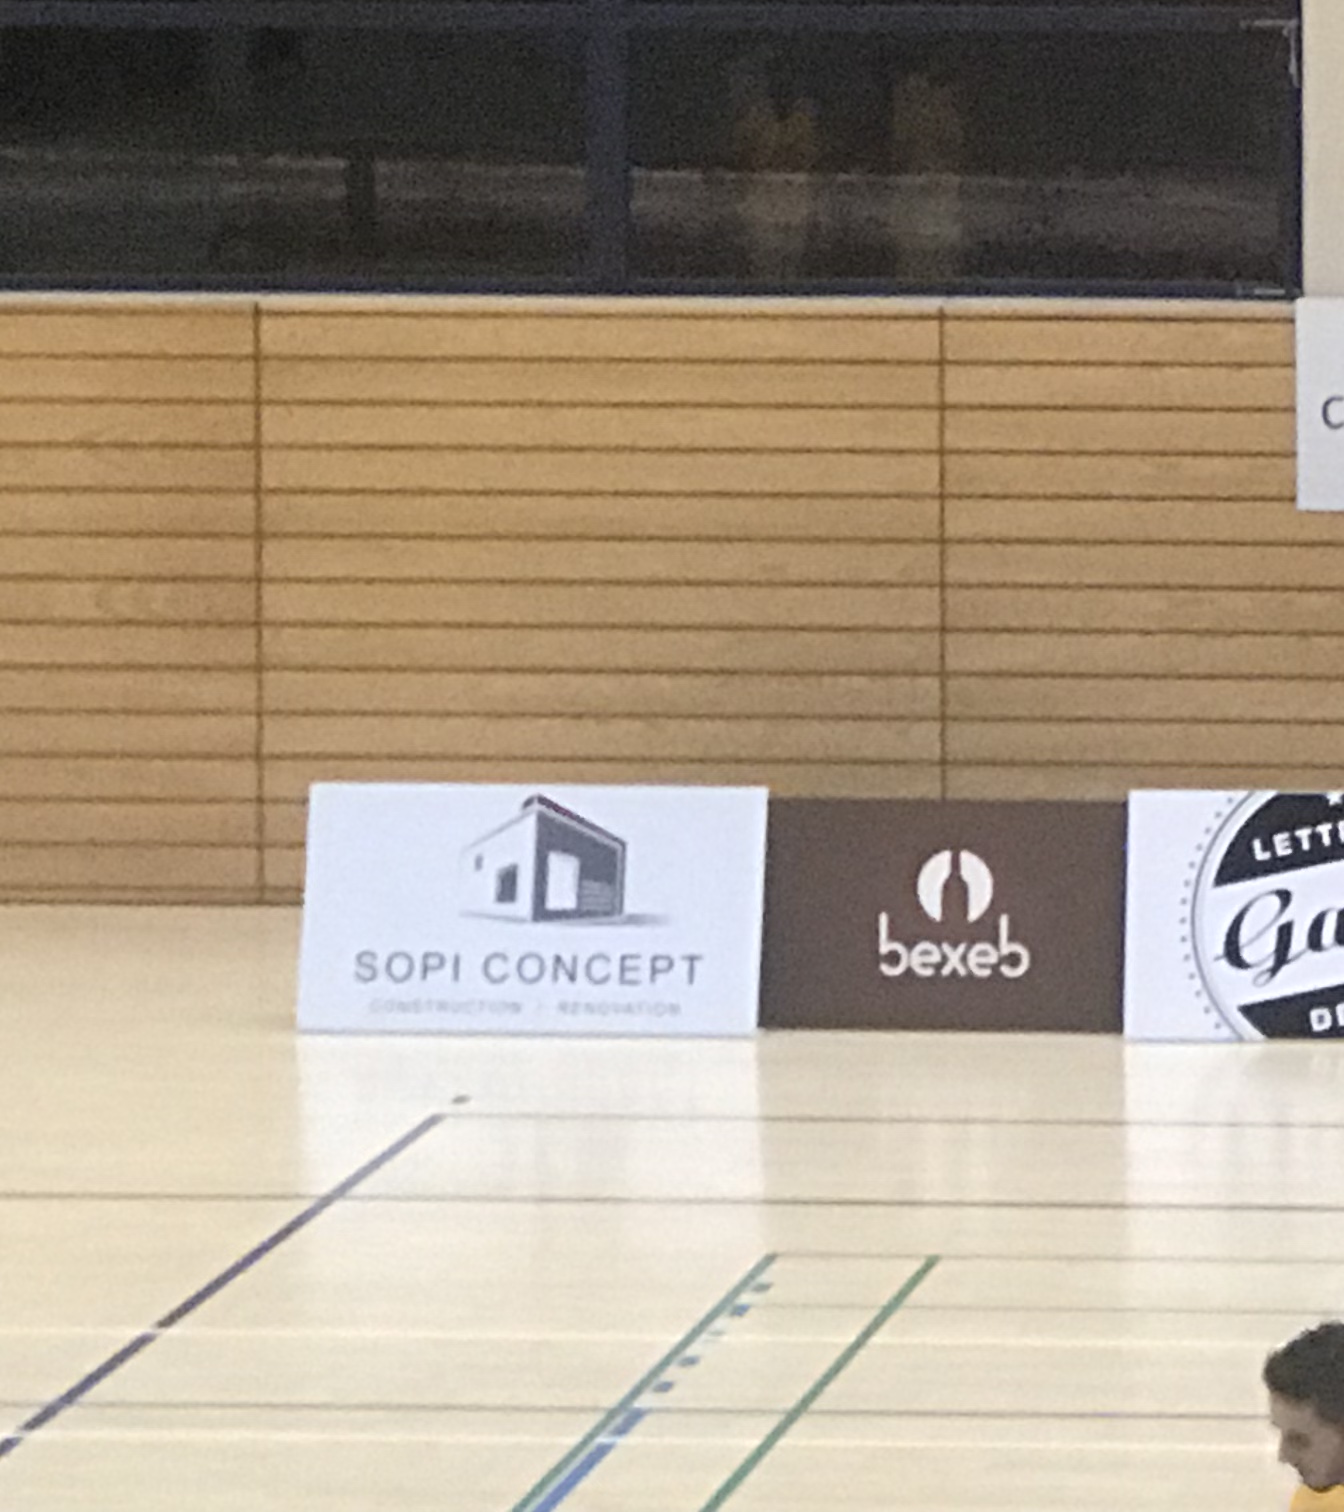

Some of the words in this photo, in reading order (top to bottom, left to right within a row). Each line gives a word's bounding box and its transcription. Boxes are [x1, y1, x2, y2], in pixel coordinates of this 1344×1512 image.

[354, 950, 460, 984] SOPI
[482, 952, 703, 986] CONCEPT
[879, 912, 1030, 978] bexeb
